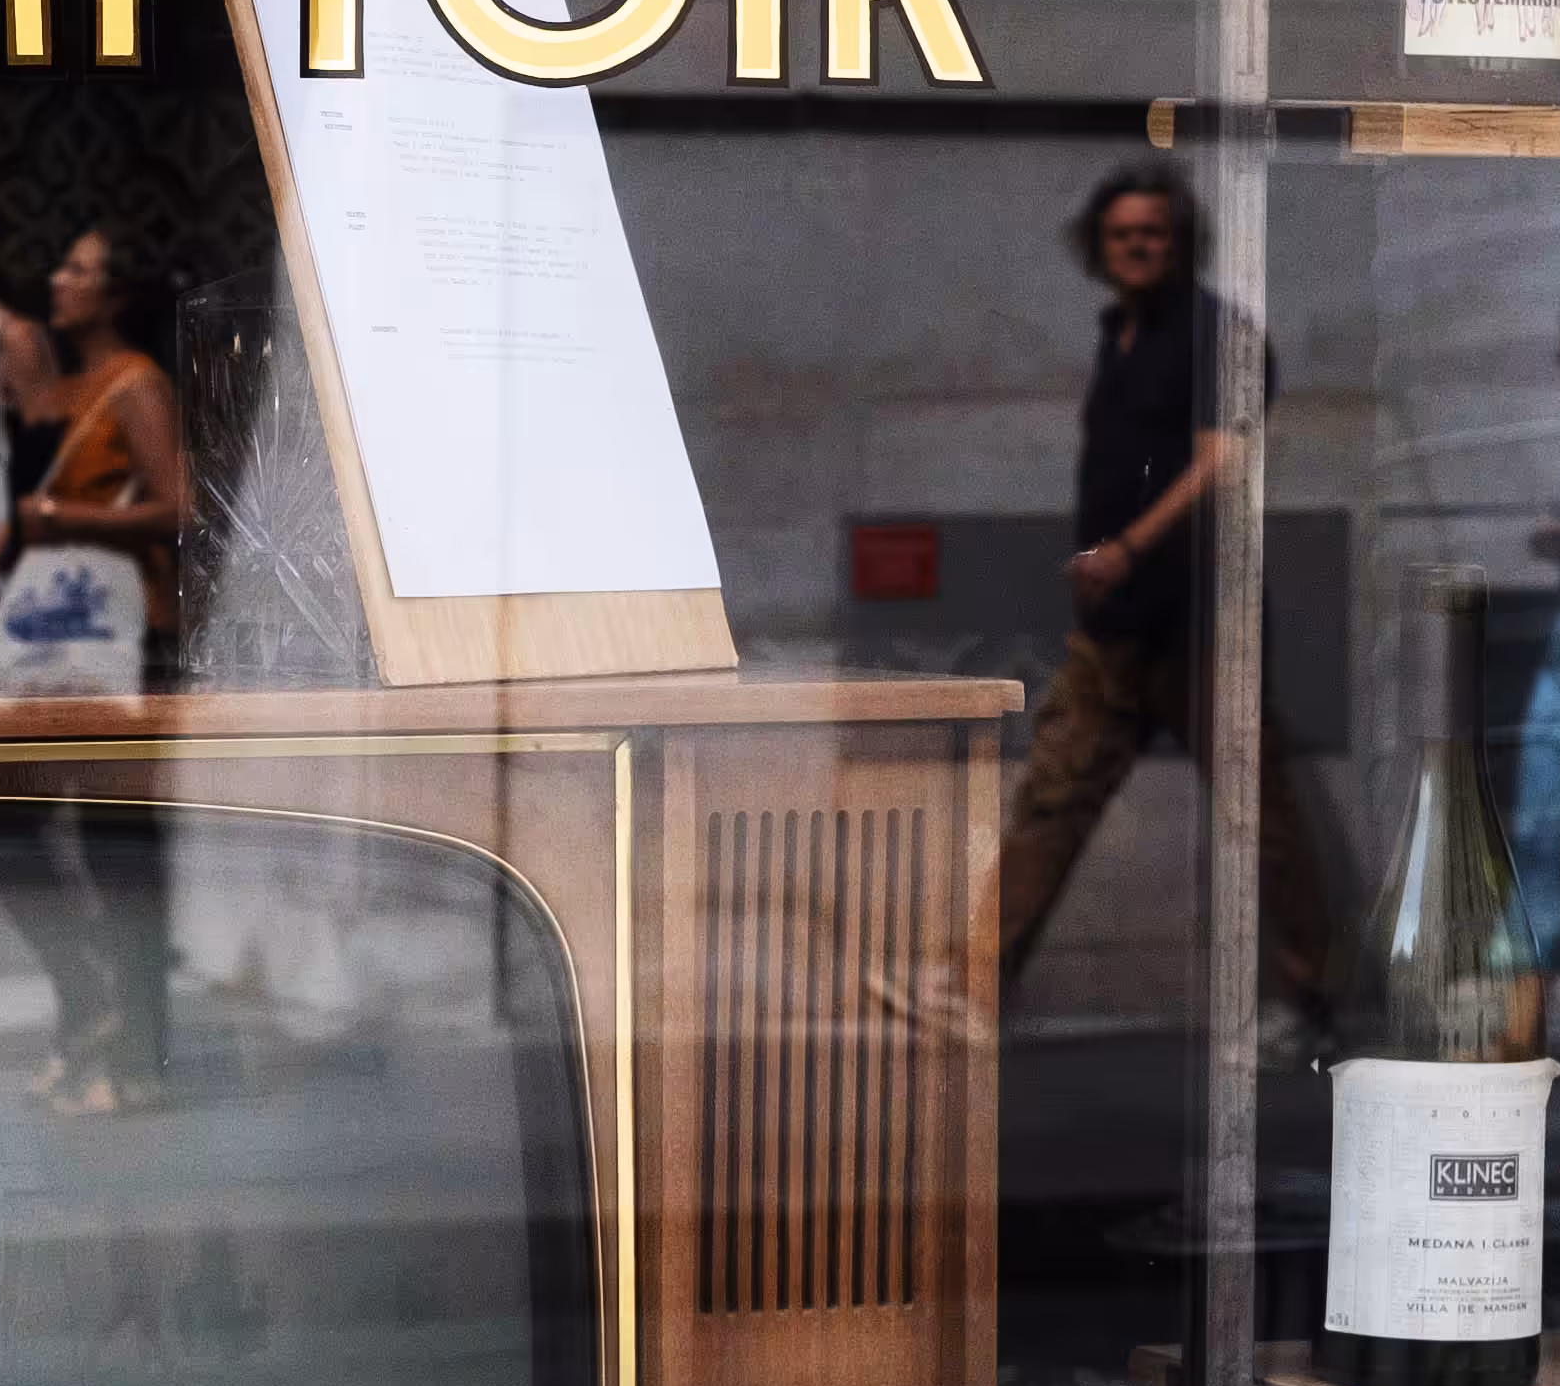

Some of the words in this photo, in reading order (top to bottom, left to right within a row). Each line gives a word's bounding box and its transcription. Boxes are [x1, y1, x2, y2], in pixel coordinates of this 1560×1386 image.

[1436, 1161, 1515, 1185] KLINEC
[1408, 1237, 1475, 1250] MEDANA
[1406, 1302, 1448, 1314] VILLA
[1457, 1303, 1475, 1314] DE
